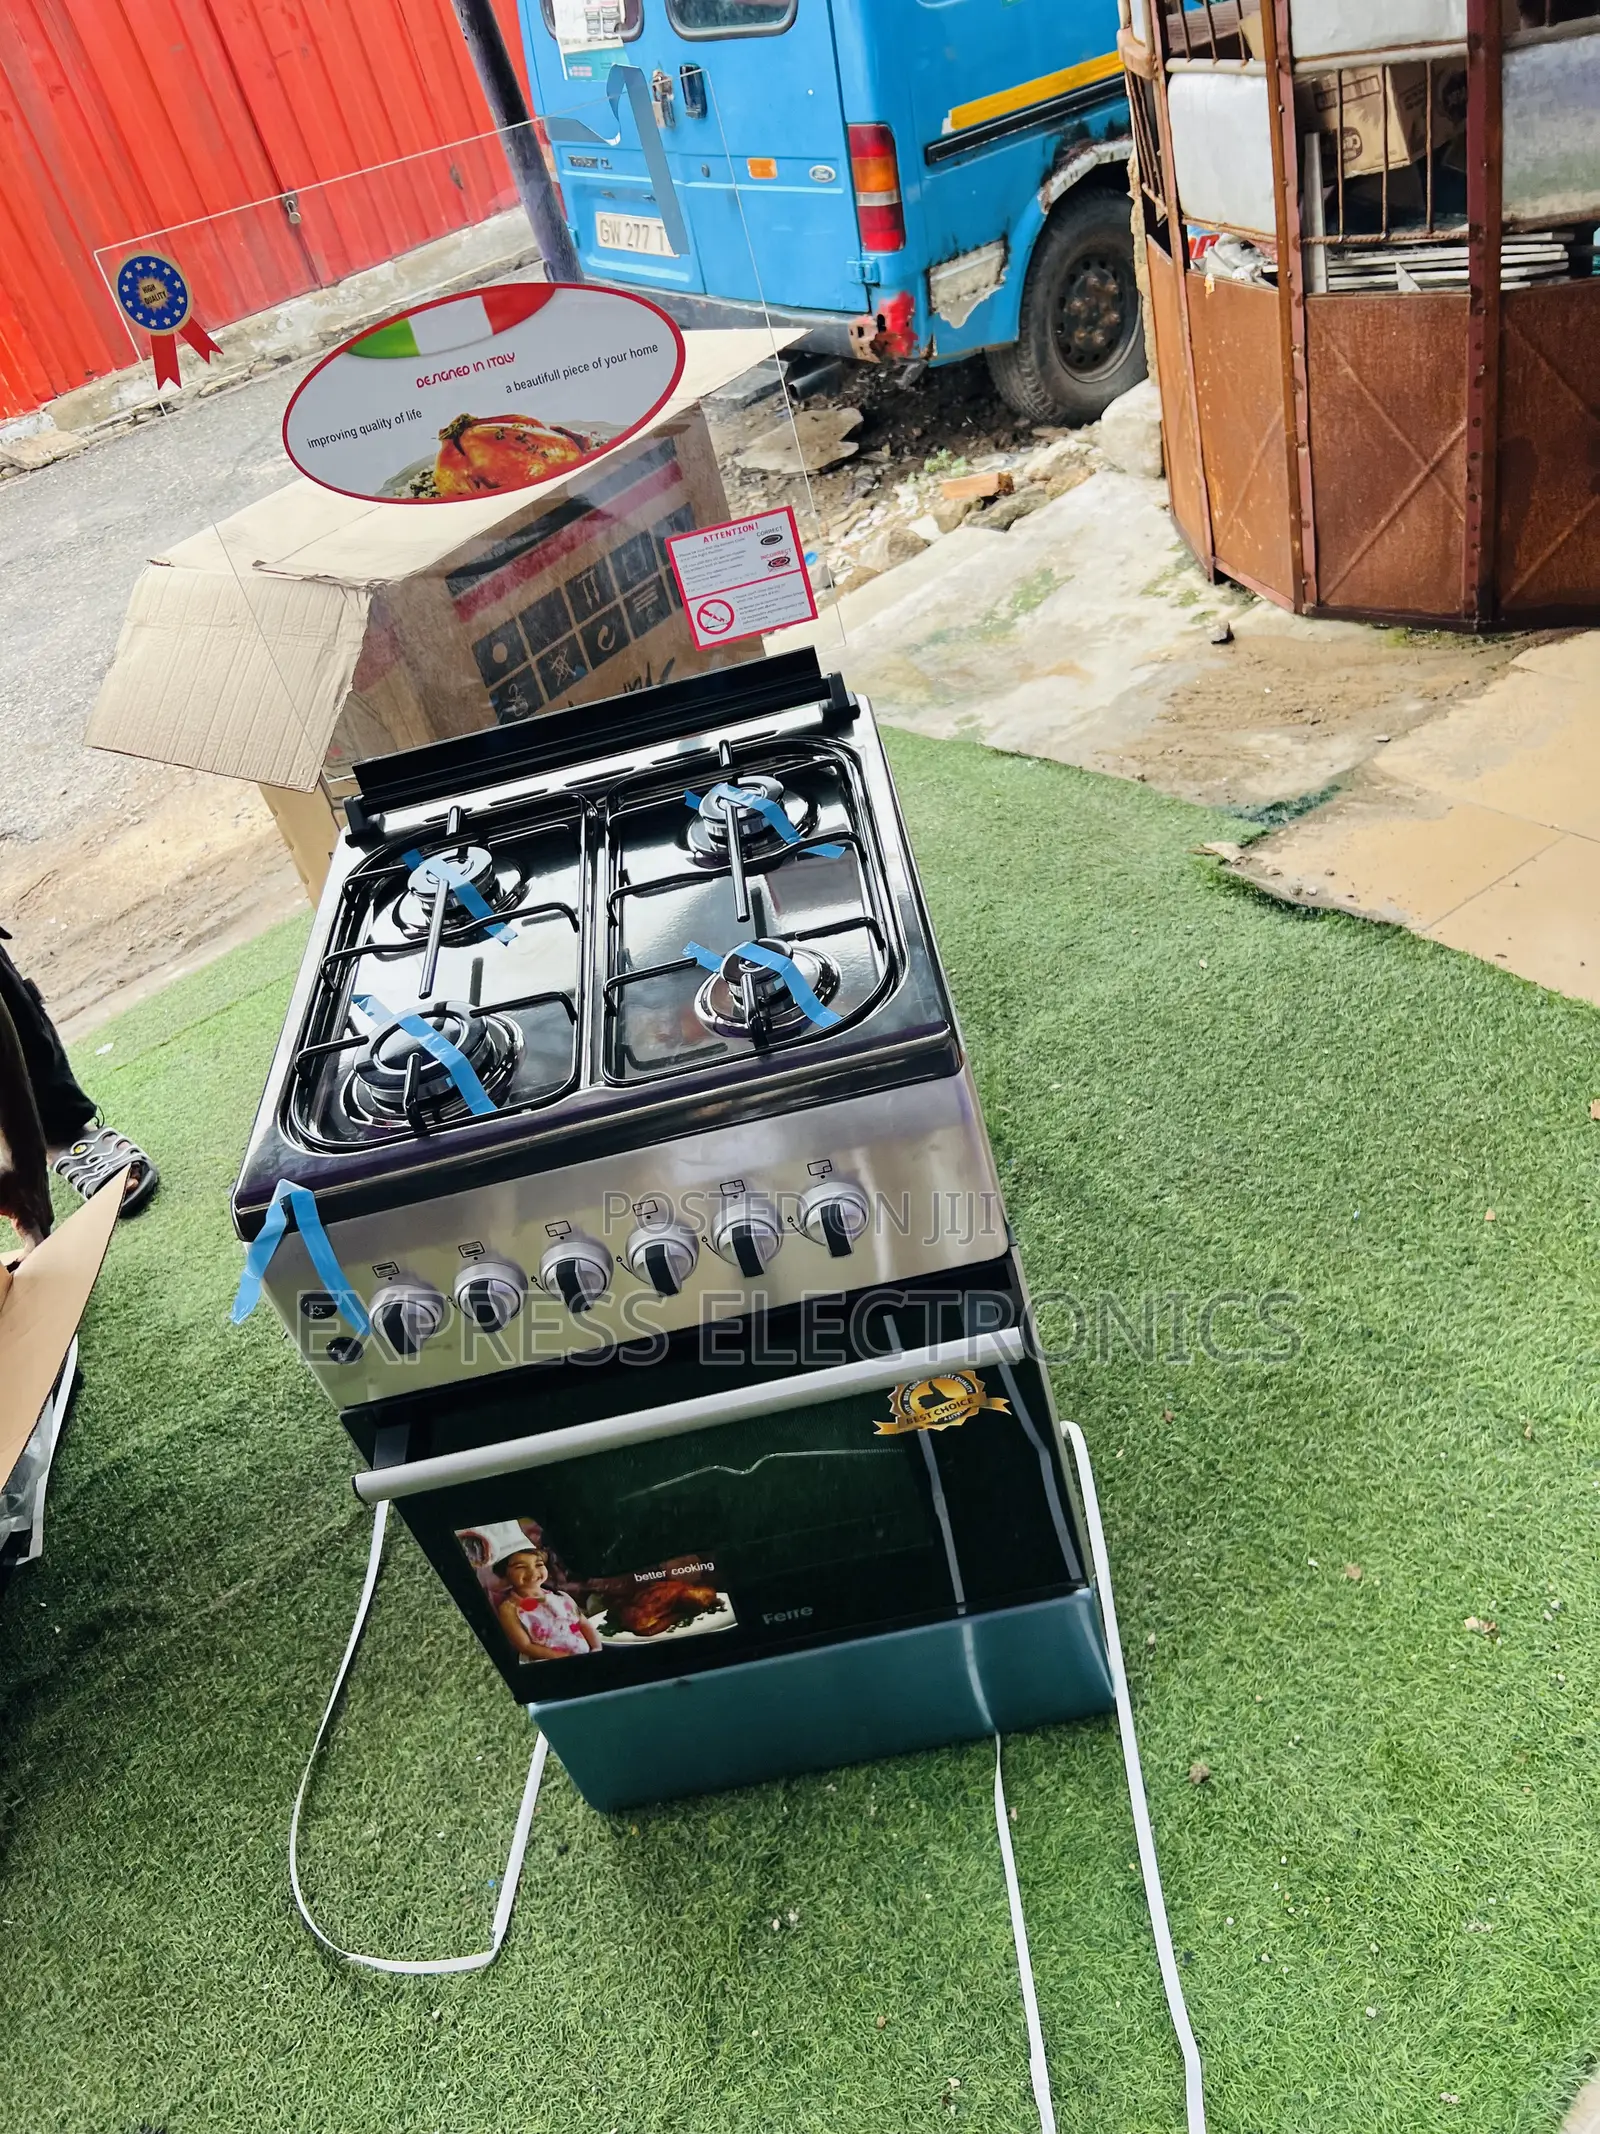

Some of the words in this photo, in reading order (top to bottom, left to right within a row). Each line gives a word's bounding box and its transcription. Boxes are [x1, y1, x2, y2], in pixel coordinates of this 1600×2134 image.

[600, 219, 621, 244] GW
[625, 222, 650, 248] 277
[142, 284, 156, 293] HIGH
[144, 291, 167, 305] QUALITY
[416, 364, 470, 388] DESIGNED
[472, 361, 485, 373] IN
[487, 352, 516, 369] ITALY
[505, 384, 512, 394] a
[514, 369, 561, 392] beautifull
[563, 362, 590, 381] piece
[592, 357, 603, 370] of
[604, 352, 628, 369] your
[629, 343, 659, 359] home
[307, 428, 358, 449] improving
[360, 418, 392, 435] quality
[395, 412, 405, 425] of
[406, 408, 423, 421] life
[703, 522, 759, 544] ATTENTION!
[906, 1412, 932, 1425] BEST
[934, 1397, 975, 1416] CHOICE
[634, 1569, 668, 1582] better
[671, 1561, 715, 1577] cooking
[762, 1606, 815, 1625] Ferre
